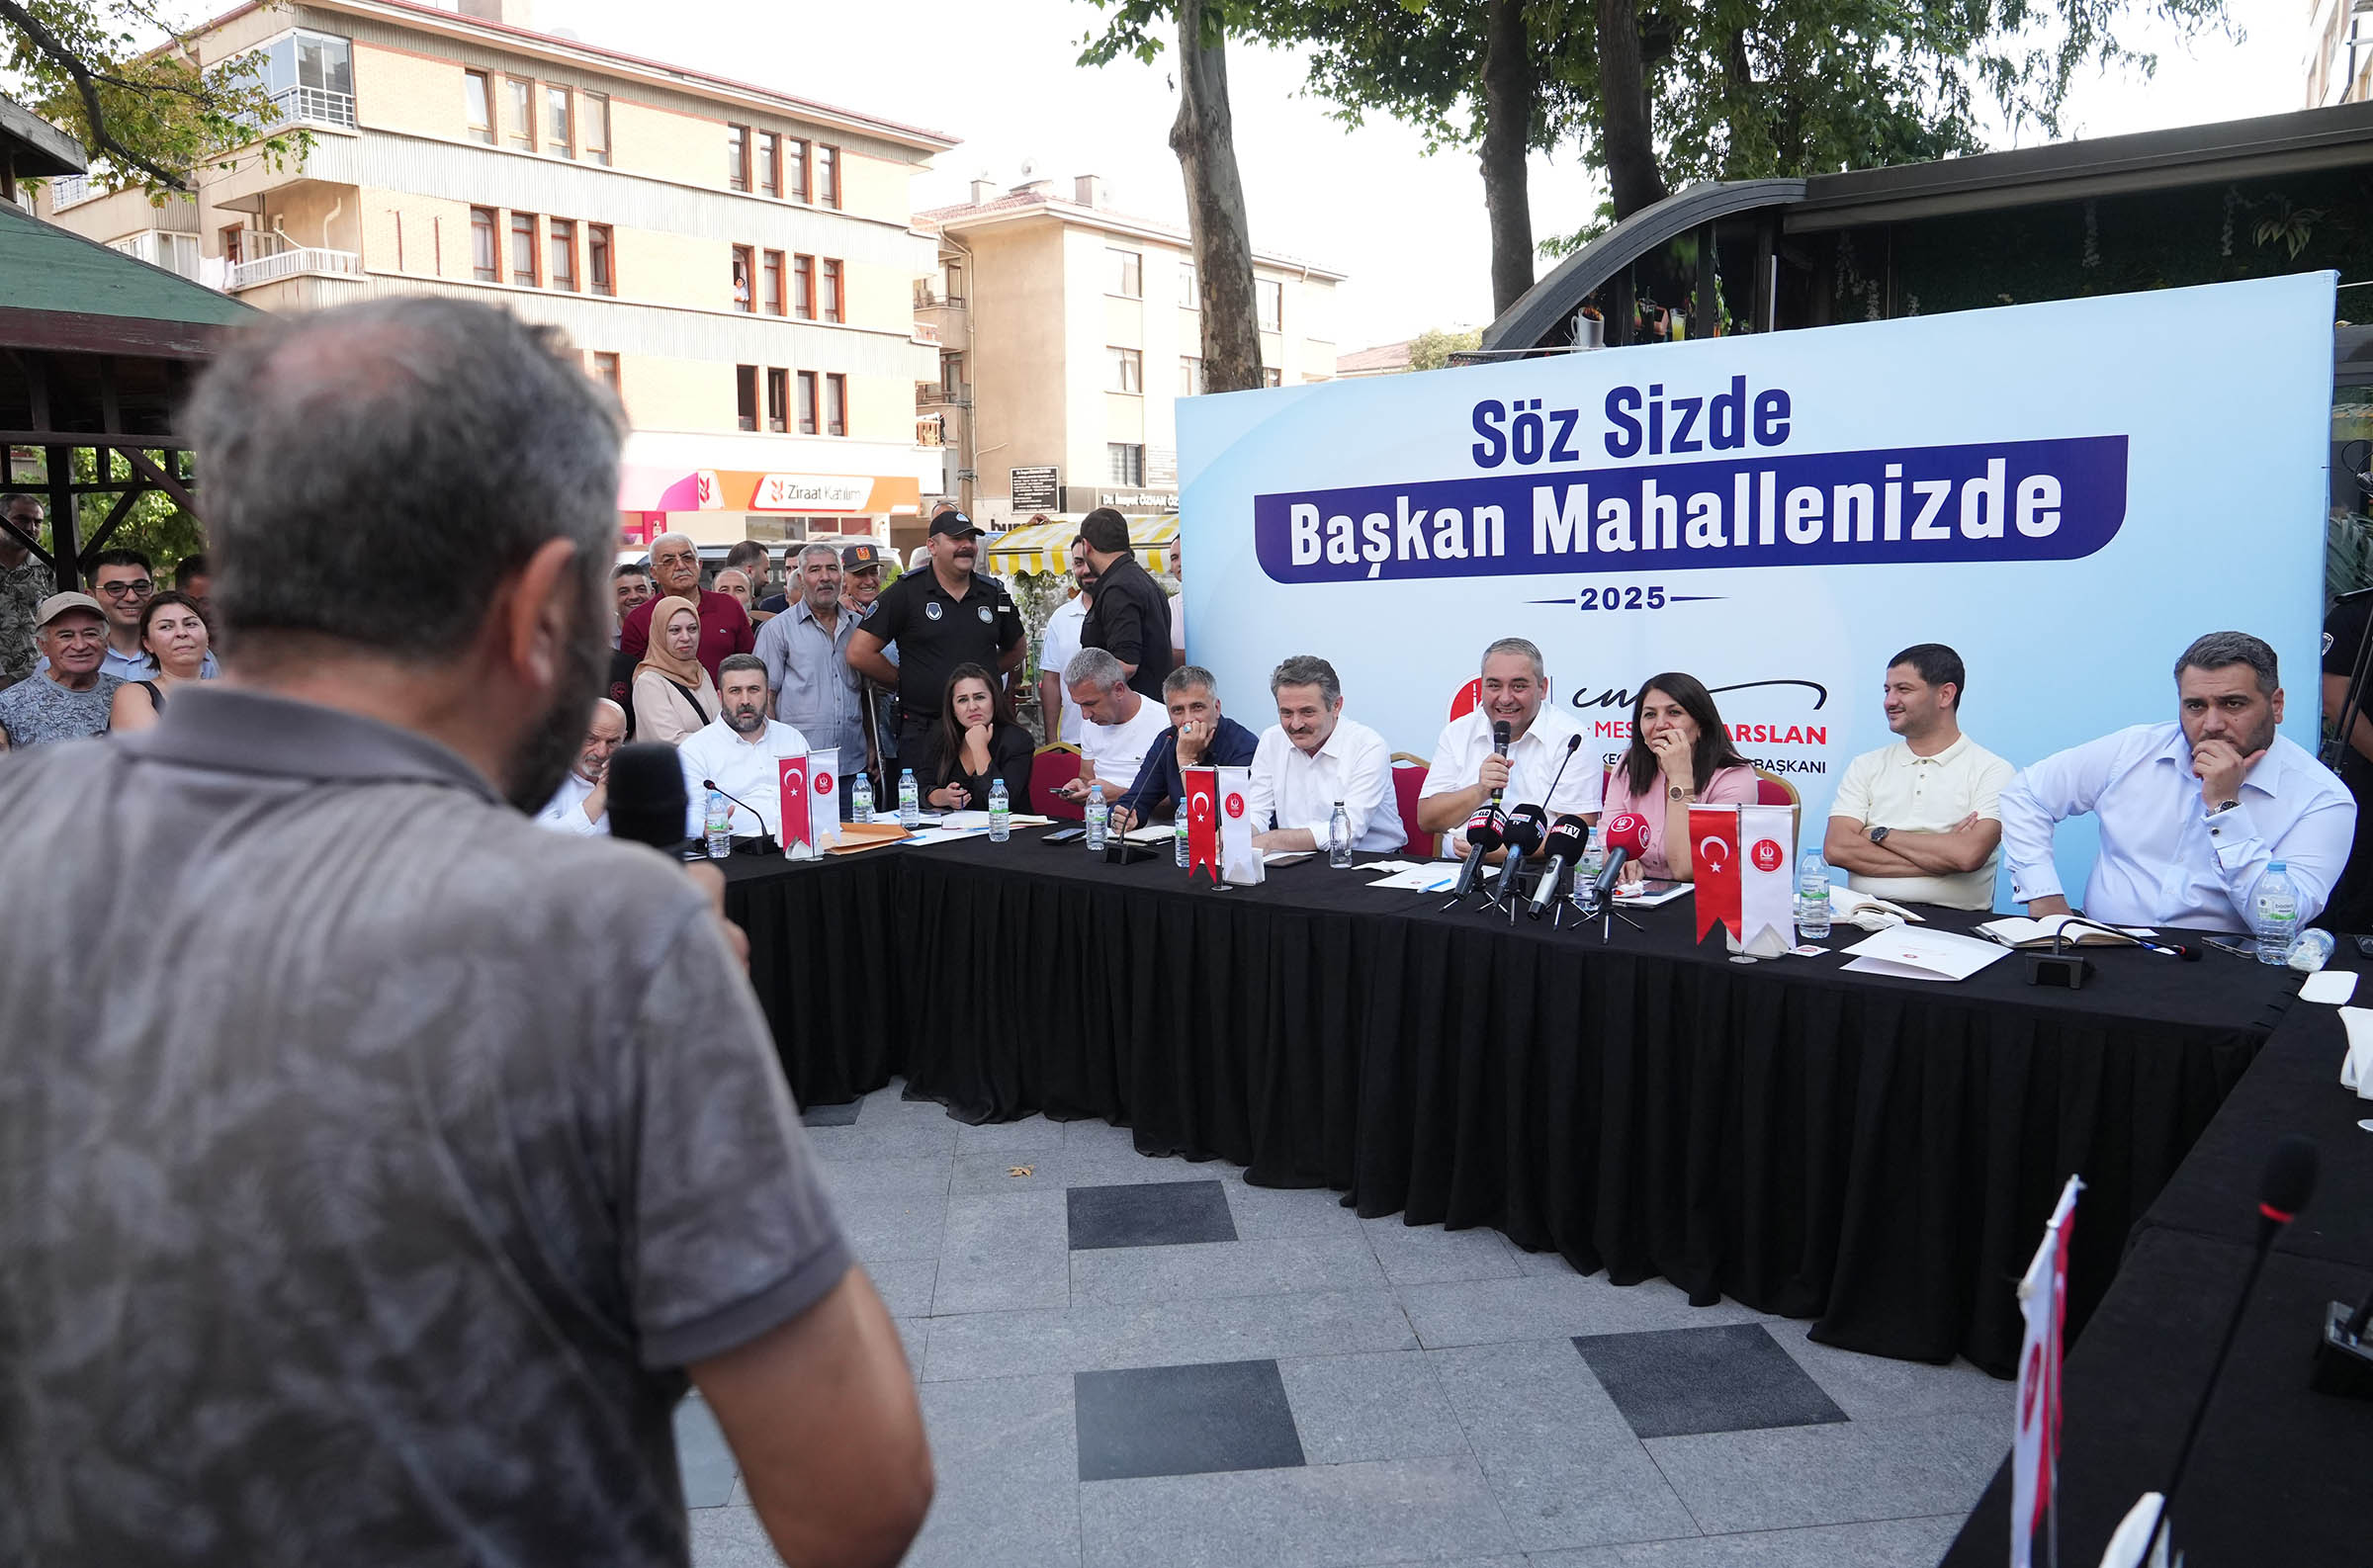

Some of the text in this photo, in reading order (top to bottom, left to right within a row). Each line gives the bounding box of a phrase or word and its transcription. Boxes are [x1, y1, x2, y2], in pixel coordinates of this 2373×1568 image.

[1471, 375, 1792, 469] Söz Sizde
[788, 484, 861, 501] Ziraat Katılım
[1290, 458, 2063, 578] Başkan Mahallenizde
[1580, 585, 1665, 611] 2025
[1595, 721, 1827, 745] MES ARSLAN
[1754, 758, 1826, 775] BAŞKANI
[1565, 825, 1579, 836] TV
